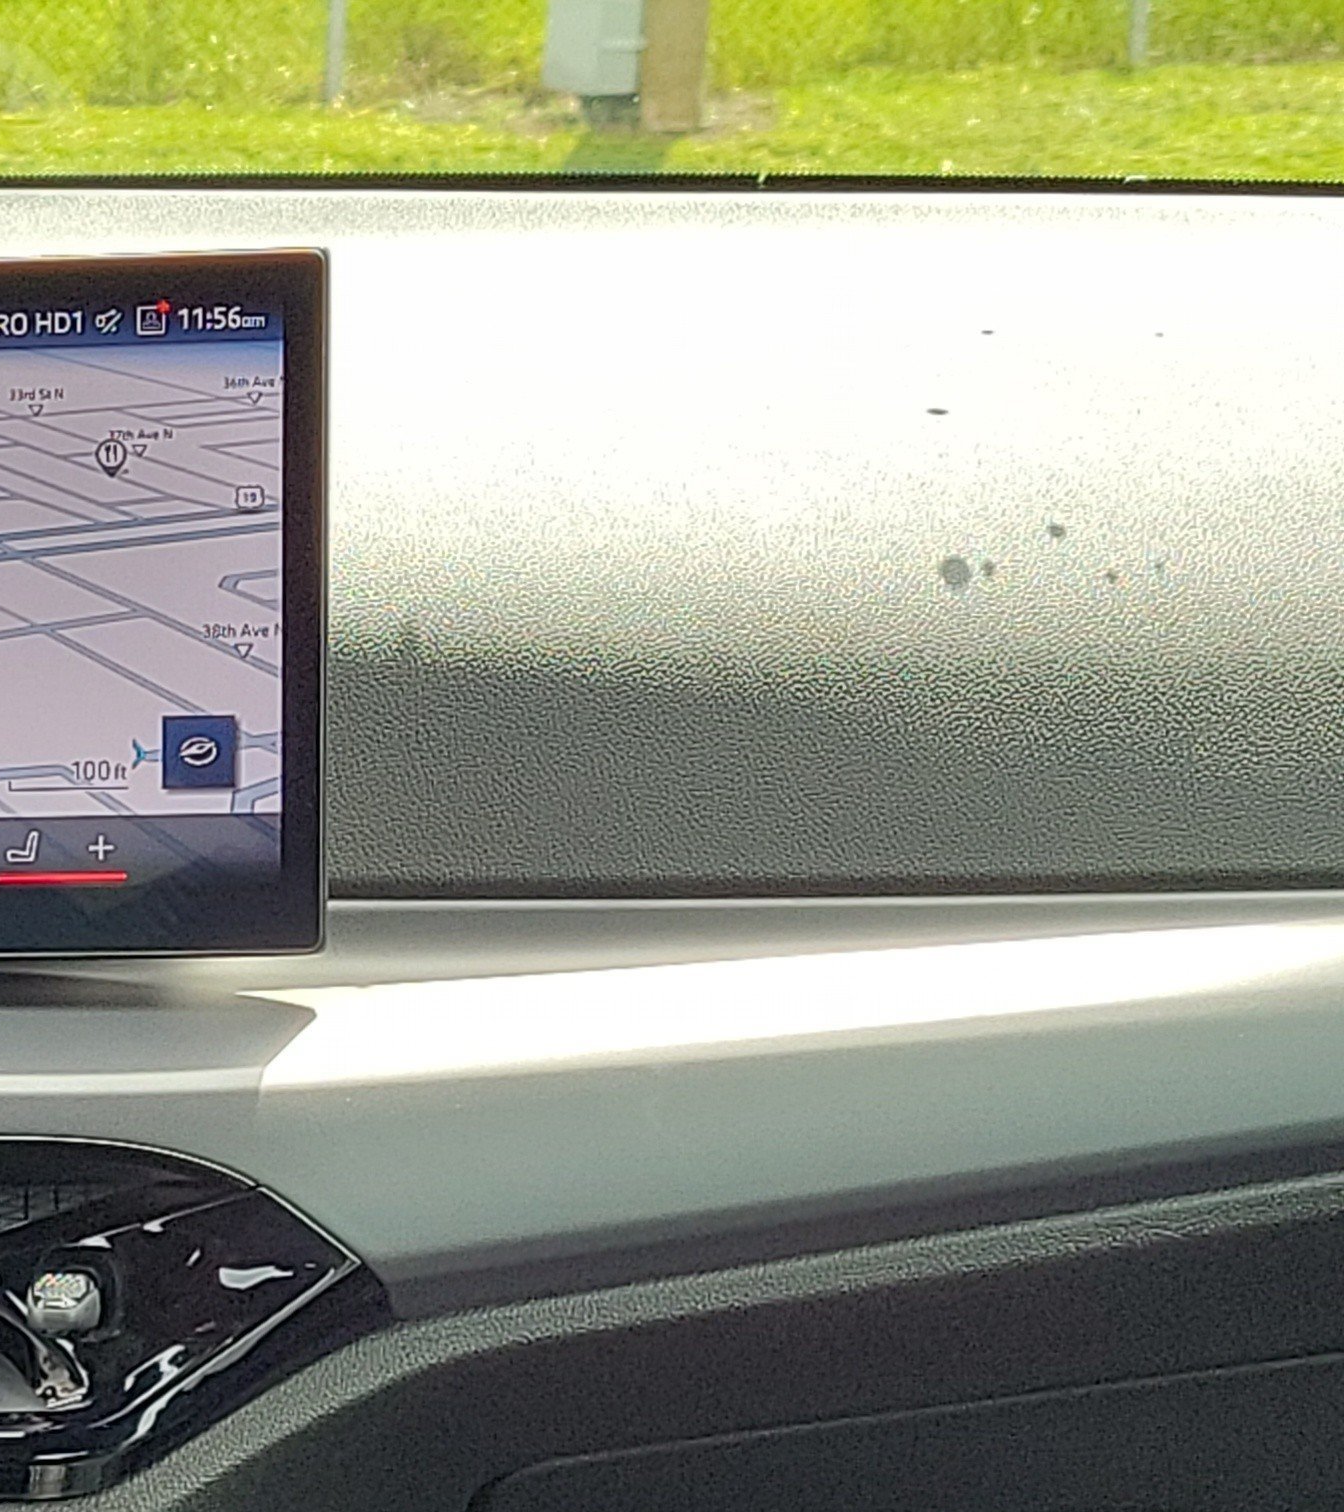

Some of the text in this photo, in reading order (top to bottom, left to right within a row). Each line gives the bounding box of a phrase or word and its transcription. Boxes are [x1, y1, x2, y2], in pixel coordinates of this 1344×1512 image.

[35, 310, 84, 335] HD1
[252, 376, 275, 388] Ave
[39, 388, 53, 400] St
[55, 388, 64, 400] N
[137, 429, 158, 440] Ave
[162, 429, 173, 439] N
[240, 623, 269, 638] Ave
[72, 760, 128, 782] 100 ft
